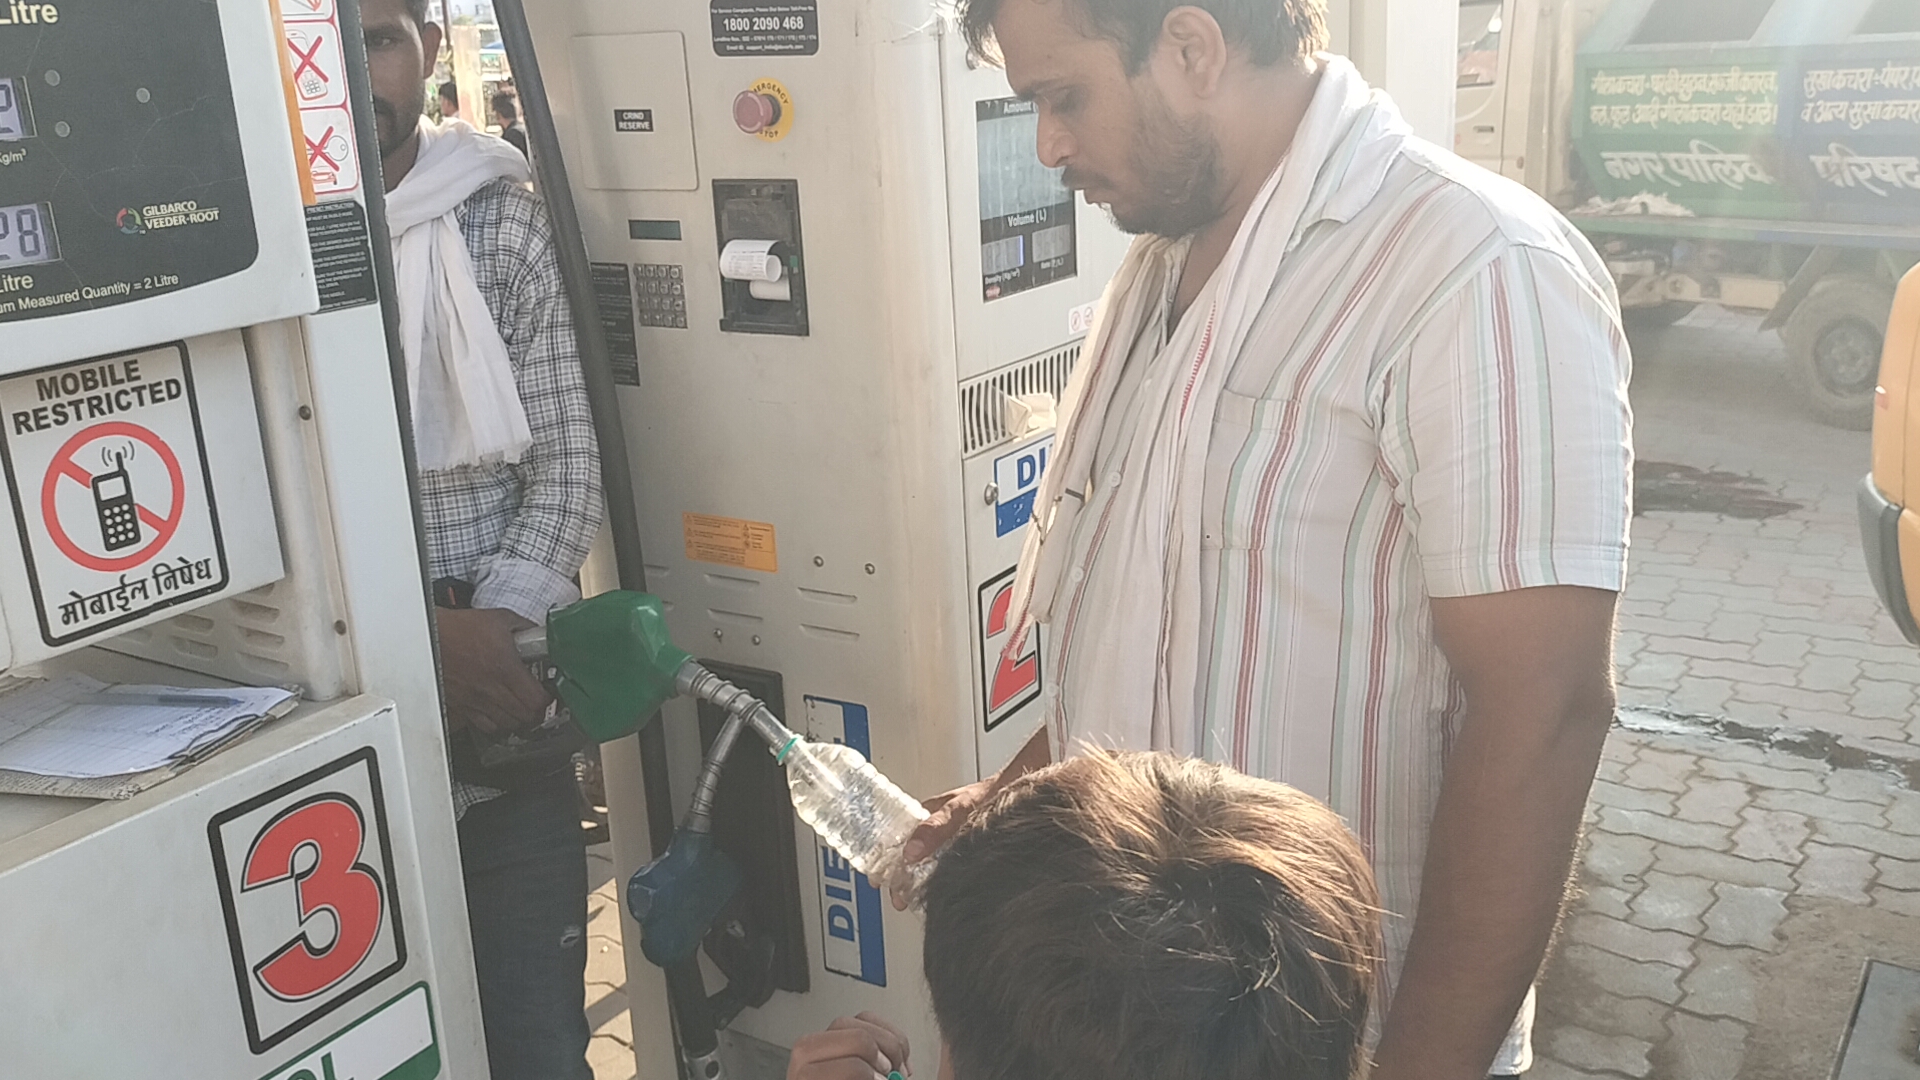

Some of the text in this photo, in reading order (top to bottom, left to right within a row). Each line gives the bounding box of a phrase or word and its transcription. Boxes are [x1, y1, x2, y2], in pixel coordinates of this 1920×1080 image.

[0, 0, 58, 25] itre
[723, 16, 804, 32] 1800 2090 468
[1003, 100, 1031, 115] Amount
[618, 121, 651, 130] RESERVE
[143, 200, 197, 217] GILBARCO
[1007, 213, 1035, 228] Volume
[0, 274, 34, 293] itre
[18, 289, 80, 311] Measured
[82, 281, 131, 299] Quantity
[144, 278, 152, 290] 2
[154, 274, 179, 288] Litre
[36, 359, 142, 401] MOBILE
[12, 377, 183, 436] RESTRICTED
[58, 556, 213, 626] मोबाईल निषेध
[240, 791, 384, 1003] 3
